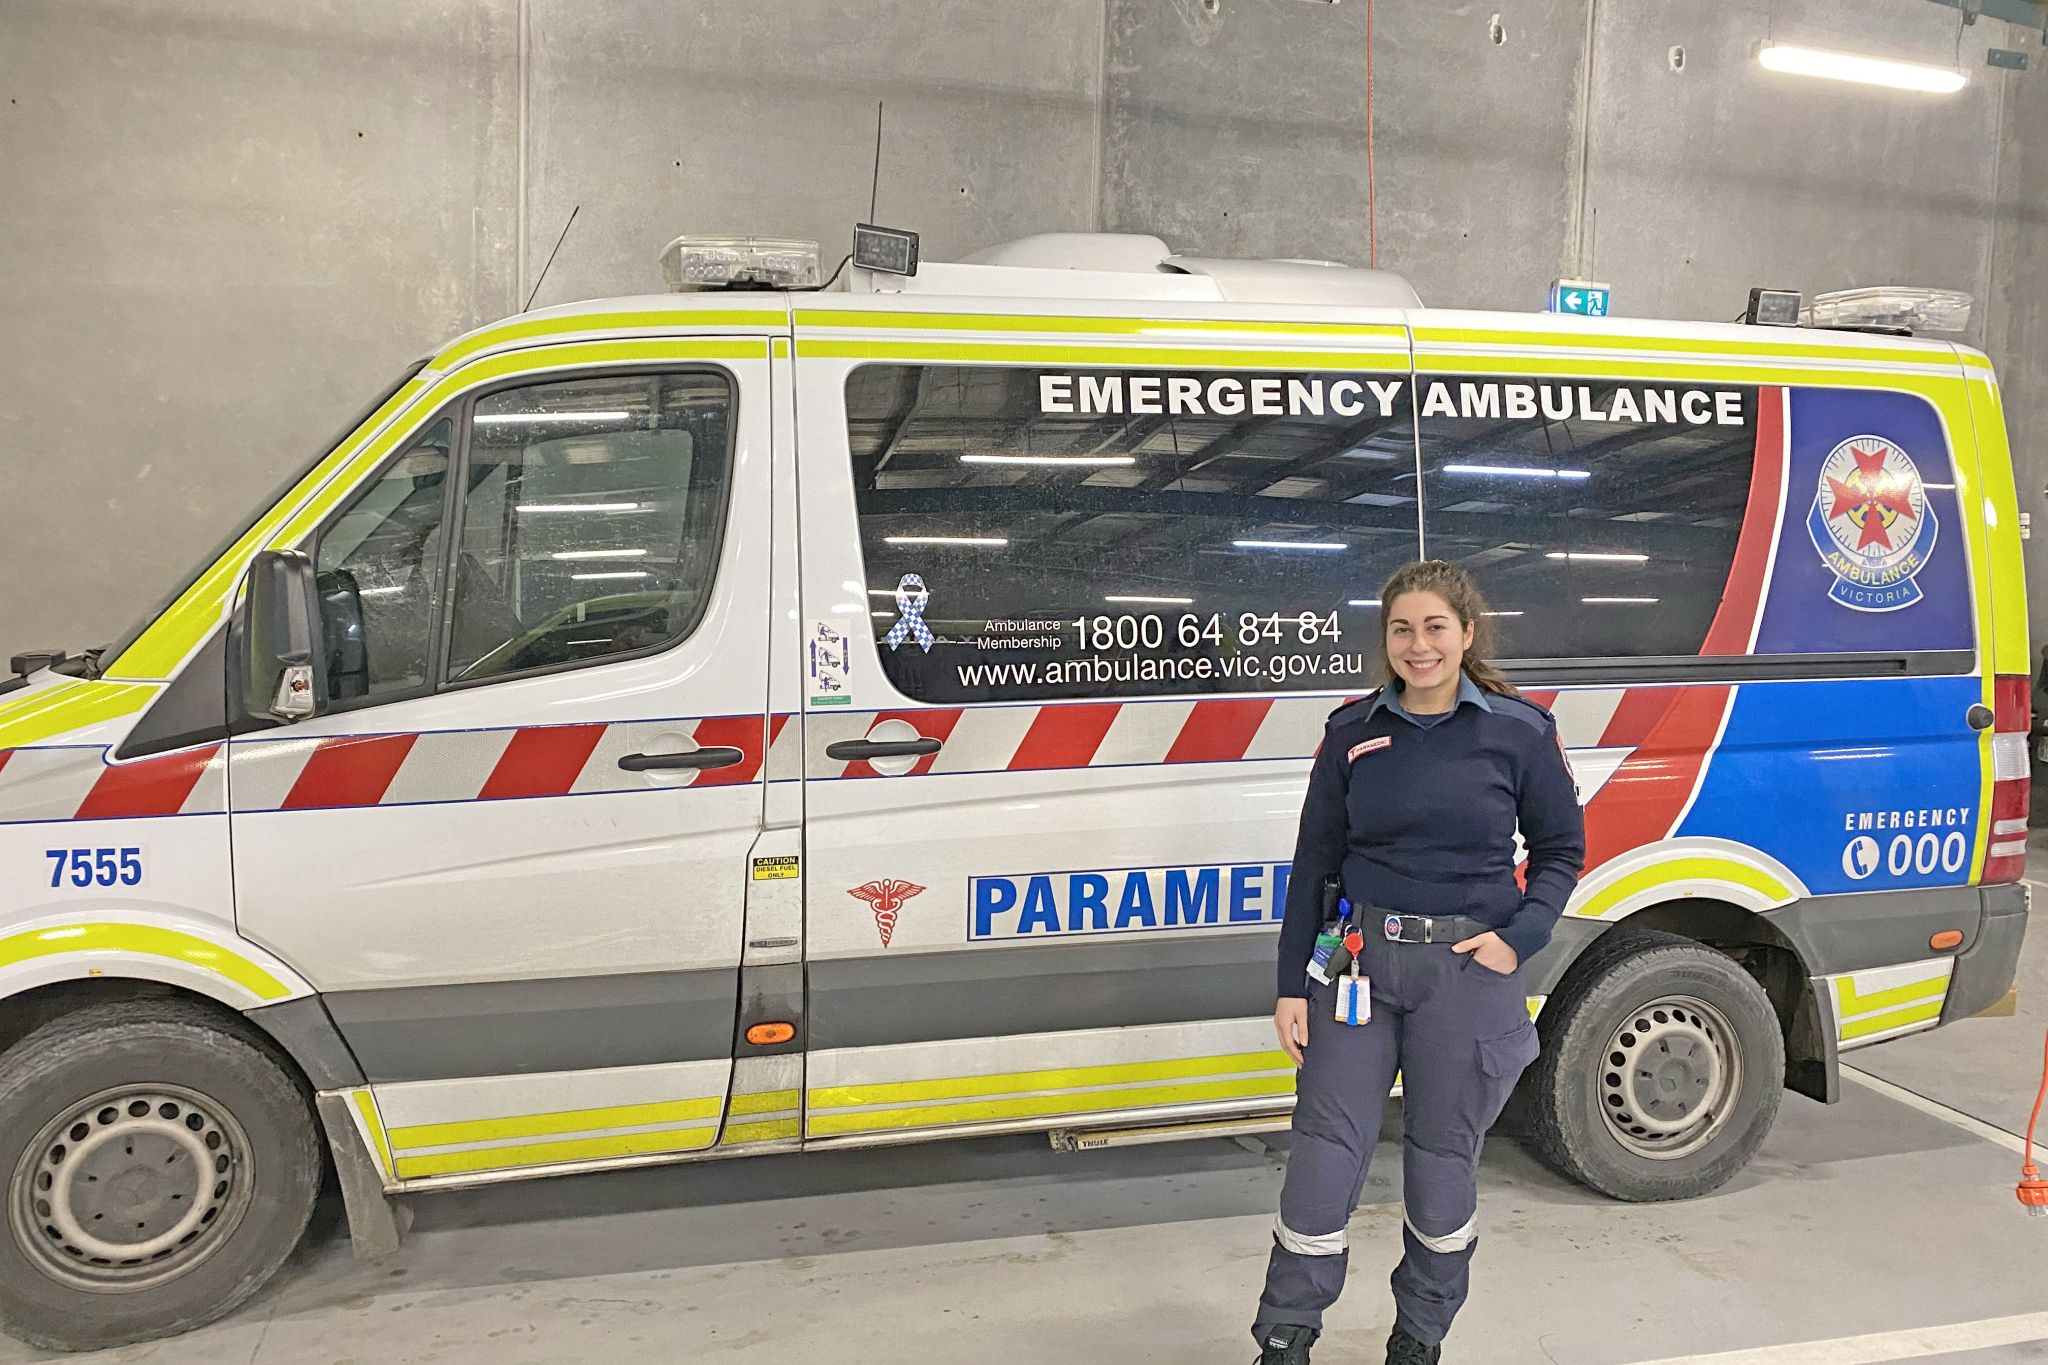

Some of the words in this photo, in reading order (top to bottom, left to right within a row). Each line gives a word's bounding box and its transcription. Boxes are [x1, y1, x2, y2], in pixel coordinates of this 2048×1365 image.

[1039, 375, 1404, 417] EMERGENCY
[1421, 382, 1745, 426] AMBULANCE
[1828, 551, 1920, 586] AMBULANCE
[1840, 585, 1911, 604] VICTORIA
[984, 618, 1061, 632] Ambulance
[1071, 614, 1164, 651] 1800
[1178, 613, 1224, 648] 64
[1238, 611, 1284, 646] 84
[1298, 610, 1343, 645] 84
[976, 634, 1062, 652] Membership
[957, 650, 1363, 687] www.ambulance.vic.gov.au
[1845, 807, 1971, 832] EMERGENCY
[45, 847, 143, 888] 7555
[756, 858, 796, 866] CAUTION
[1886, 831, 1967, 877] 000
[1082, 1139, 1109, 1147] THULE
